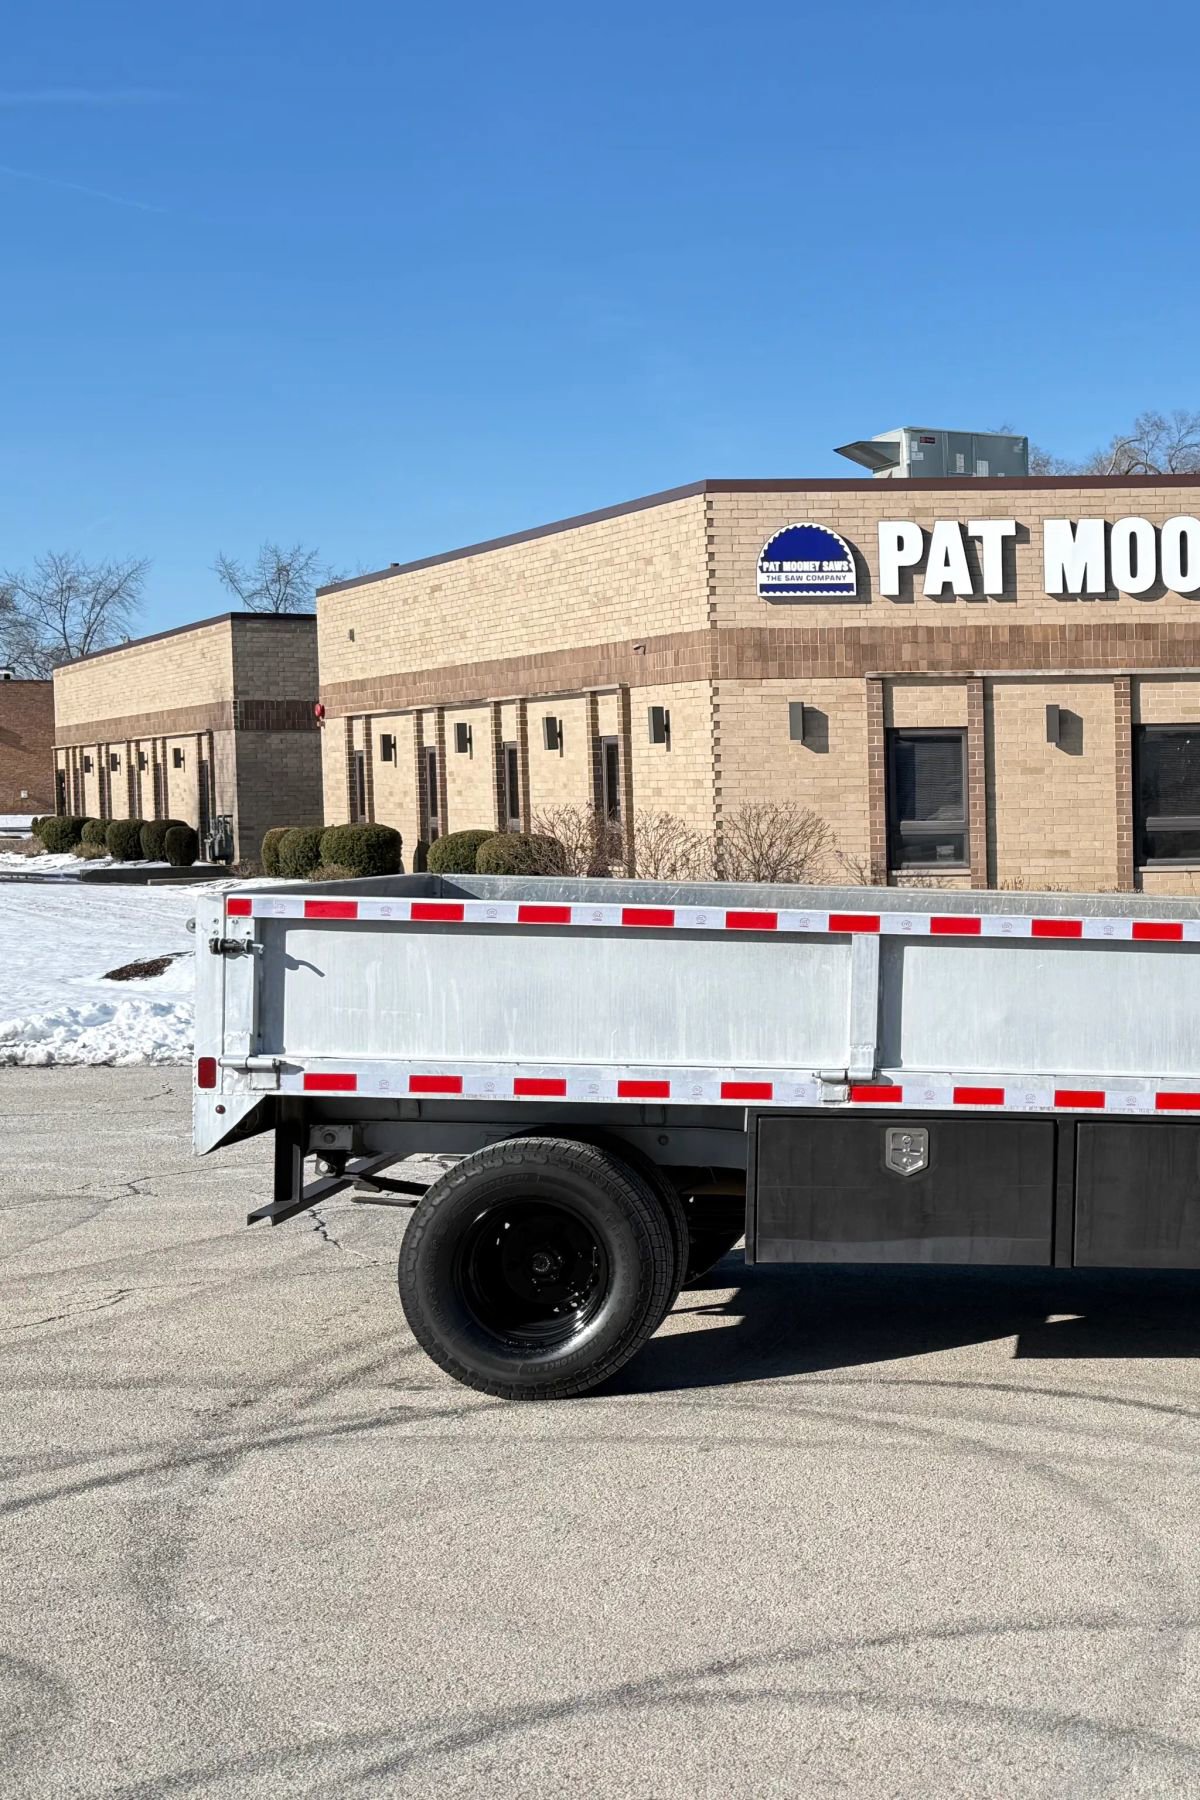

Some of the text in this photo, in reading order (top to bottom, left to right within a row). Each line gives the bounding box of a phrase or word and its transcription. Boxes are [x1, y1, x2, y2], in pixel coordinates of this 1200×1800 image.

[877, 519, 1017, 596] PAT
[762, 561, 849, 572] PAT MOONEY SAWS
[806, 574, 847, 582] COMPANY
